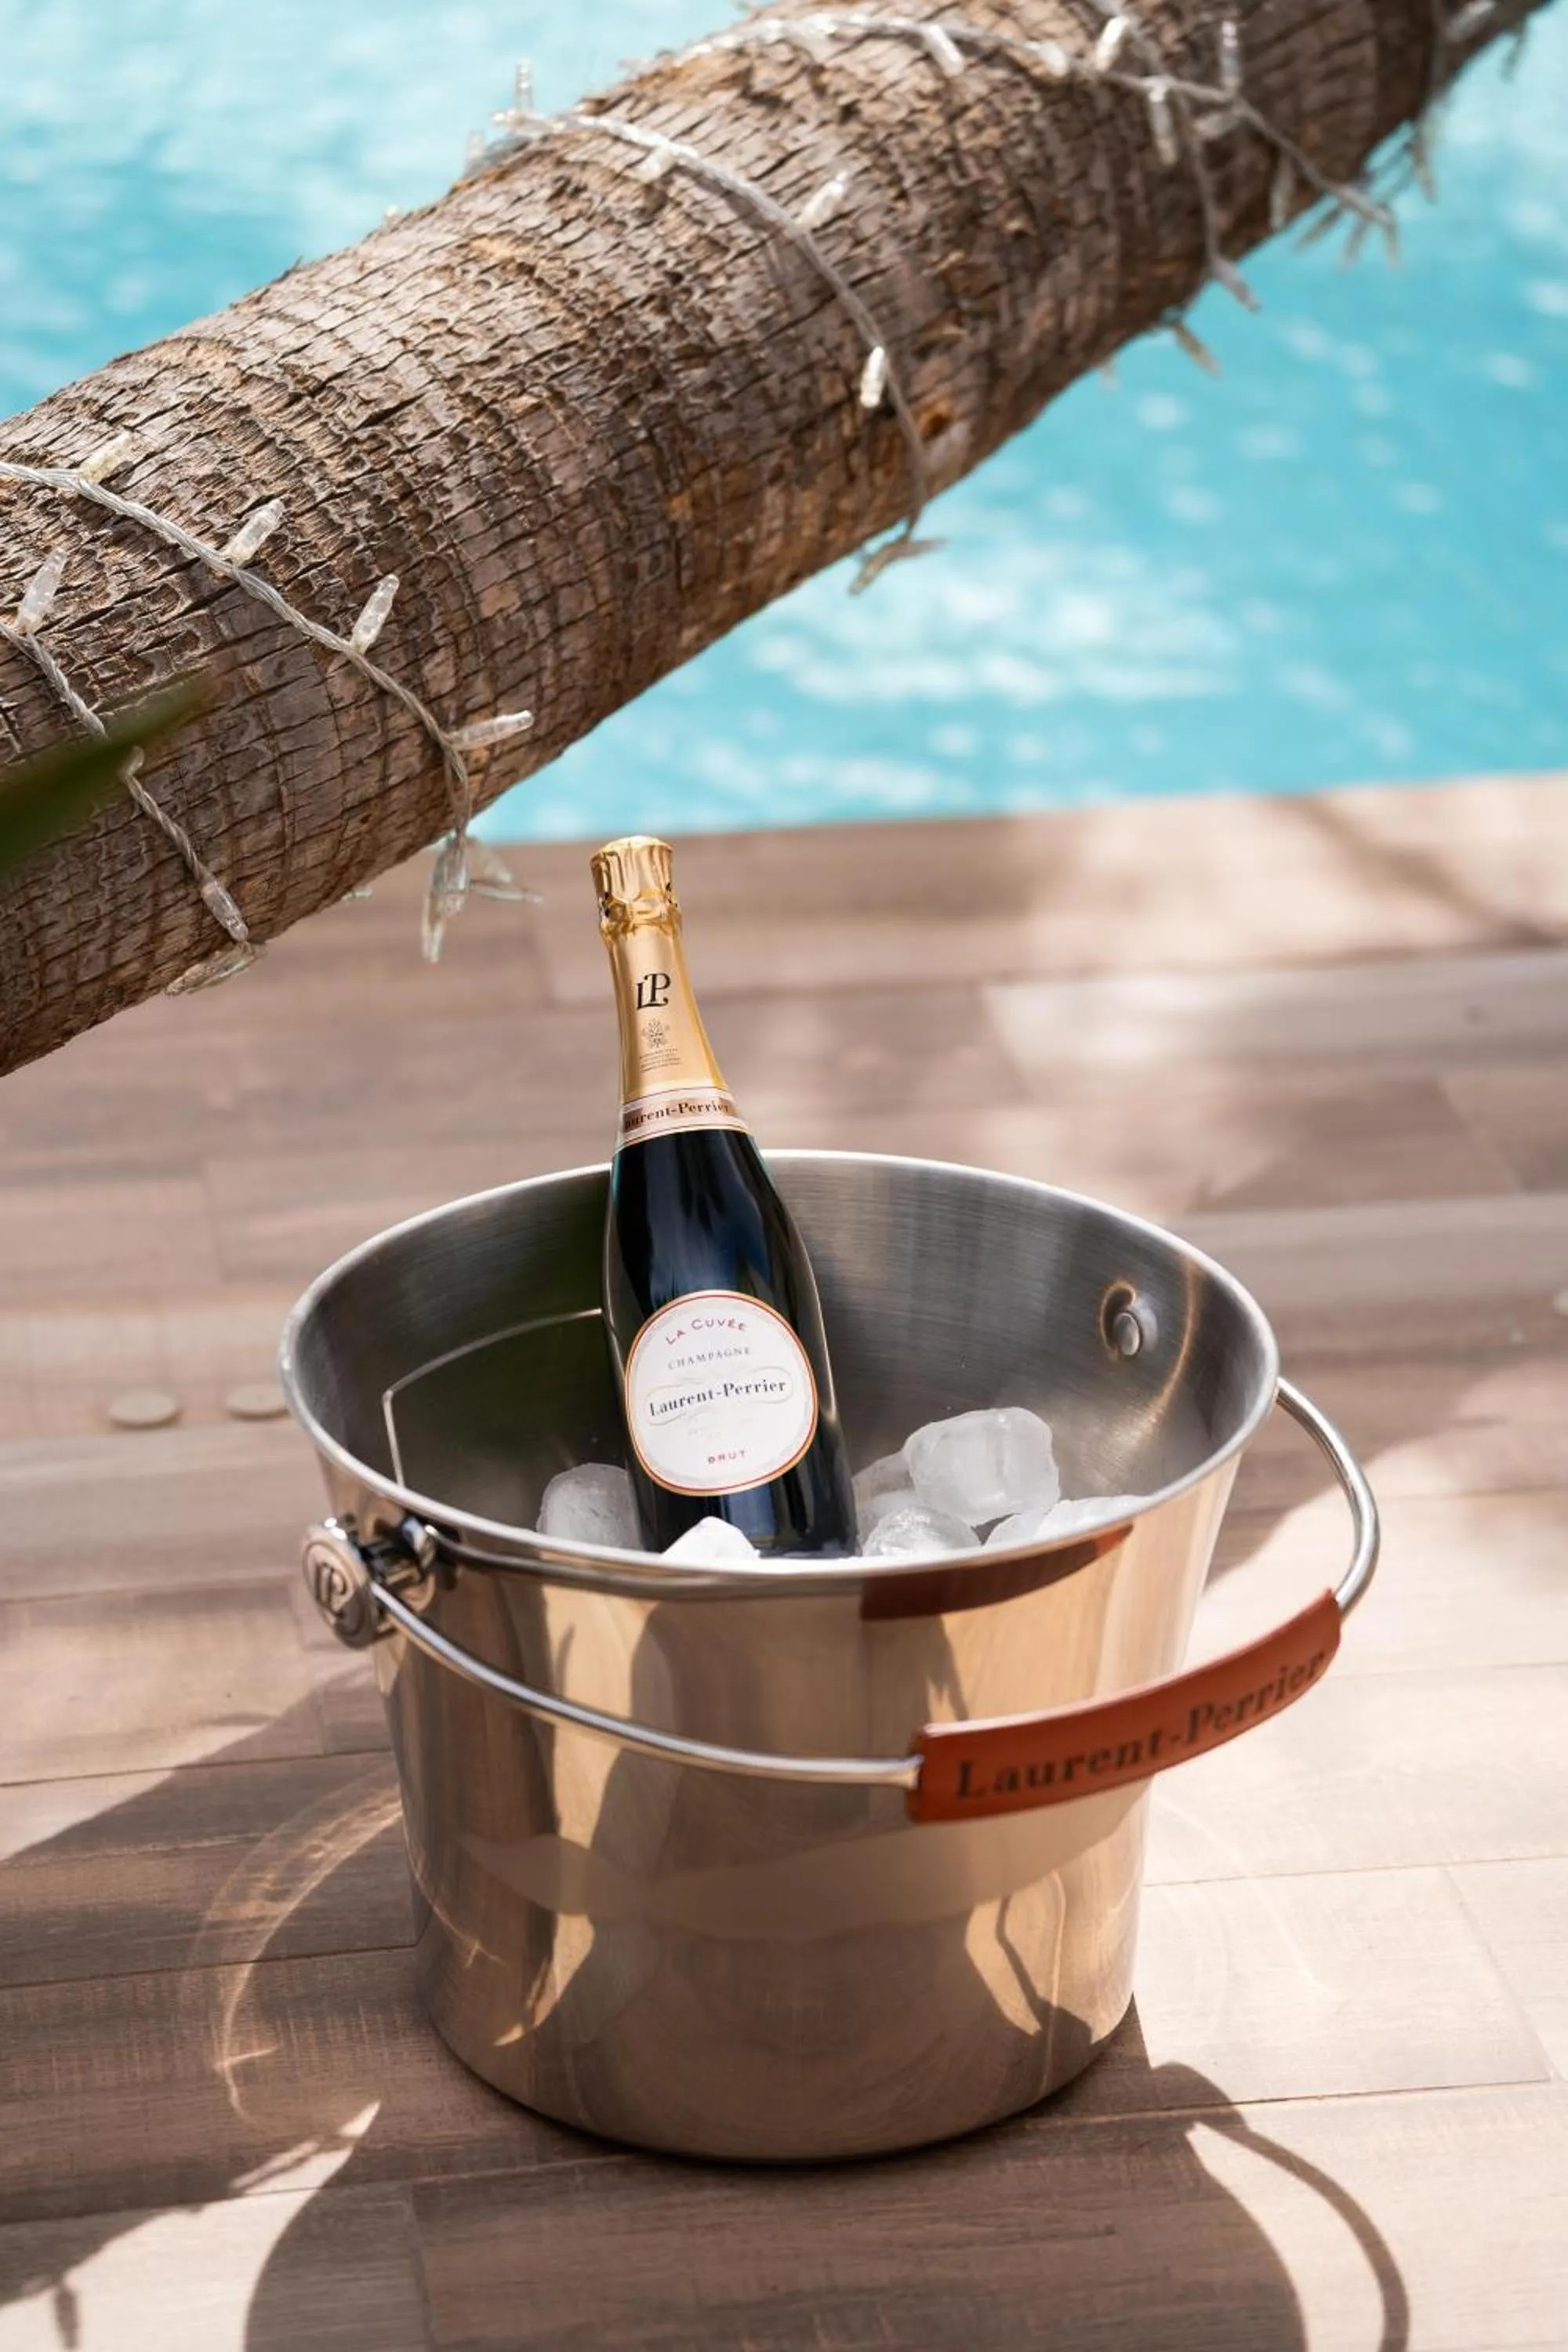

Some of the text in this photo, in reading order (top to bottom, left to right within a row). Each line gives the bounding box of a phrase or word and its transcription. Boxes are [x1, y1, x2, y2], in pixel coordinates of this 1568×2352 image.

[626, 1100, 729, 1127] aurent-Perrier
[666, 1330, 686, 1345] LA
[668, 1346, 750, 1370] CHAMPAGNE
[649, 1379, 787, 1417] Laurent-Perrier
[707, 1450, 746, 1464] BRUT
[956, 1650, 1326, 1801] Laurent-Perrier
